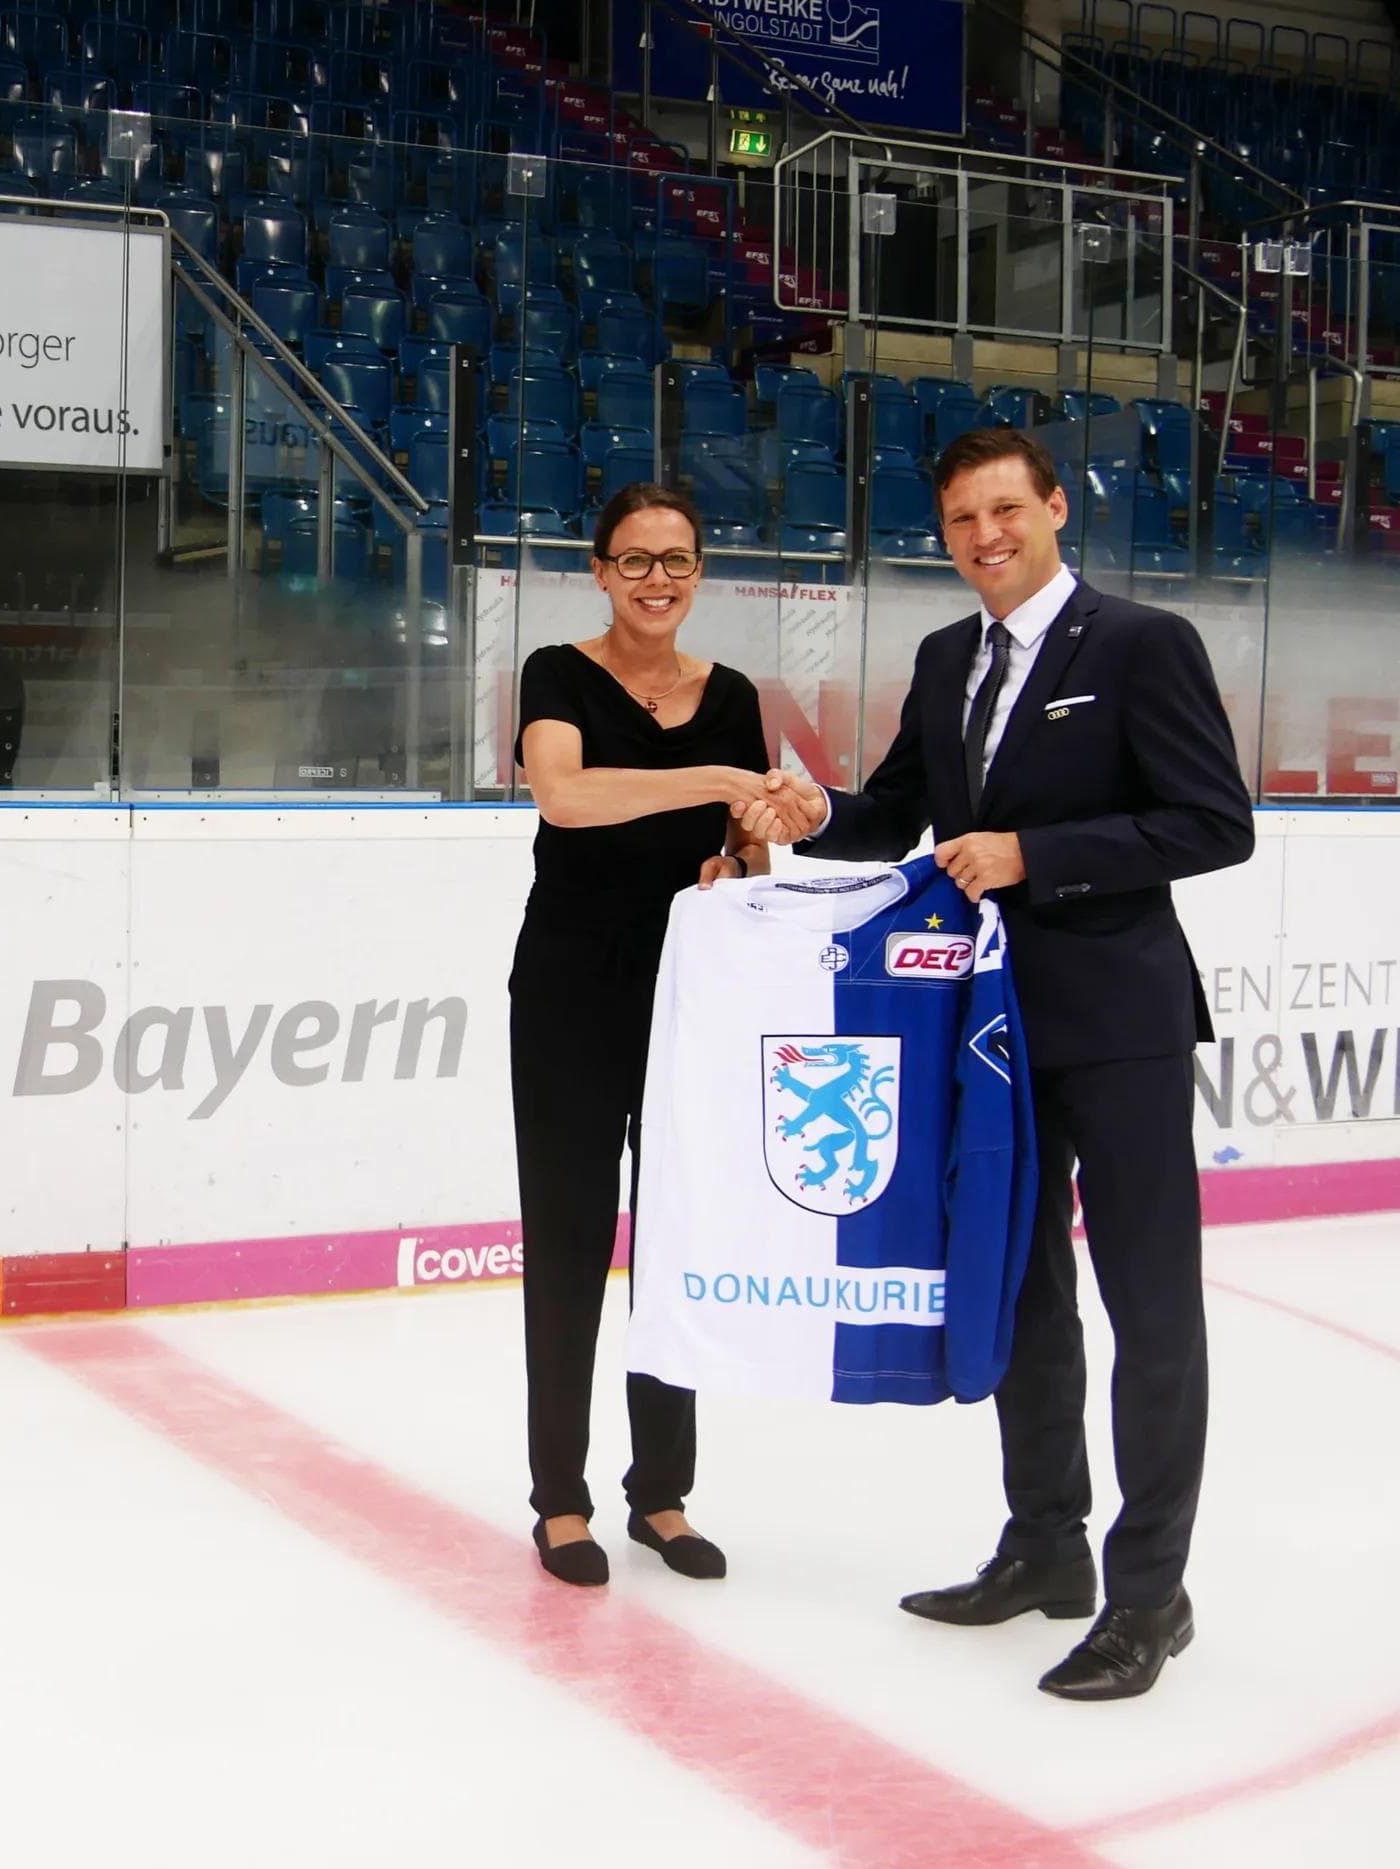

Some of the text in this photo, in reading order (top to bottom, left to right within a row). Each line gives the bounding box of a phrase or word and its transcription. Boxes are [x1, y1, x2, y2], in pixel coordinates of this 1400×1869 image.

[714, 10, 823, 41] INGOLSTADT
[868, 65, 909, 99] nah!
[11, 403, 139, 436] voraus.
[974, 898, 1008, 974] 2
[1200, 960, 1398, 1013] EN ZENT
[12, 979, 468, 1120] Bayern
[1192, 1027, 1400, 1128] N&W
[417, 1244, 523, 1281] coves
[684, 1272, 945, 1313] DONAUKURIE
